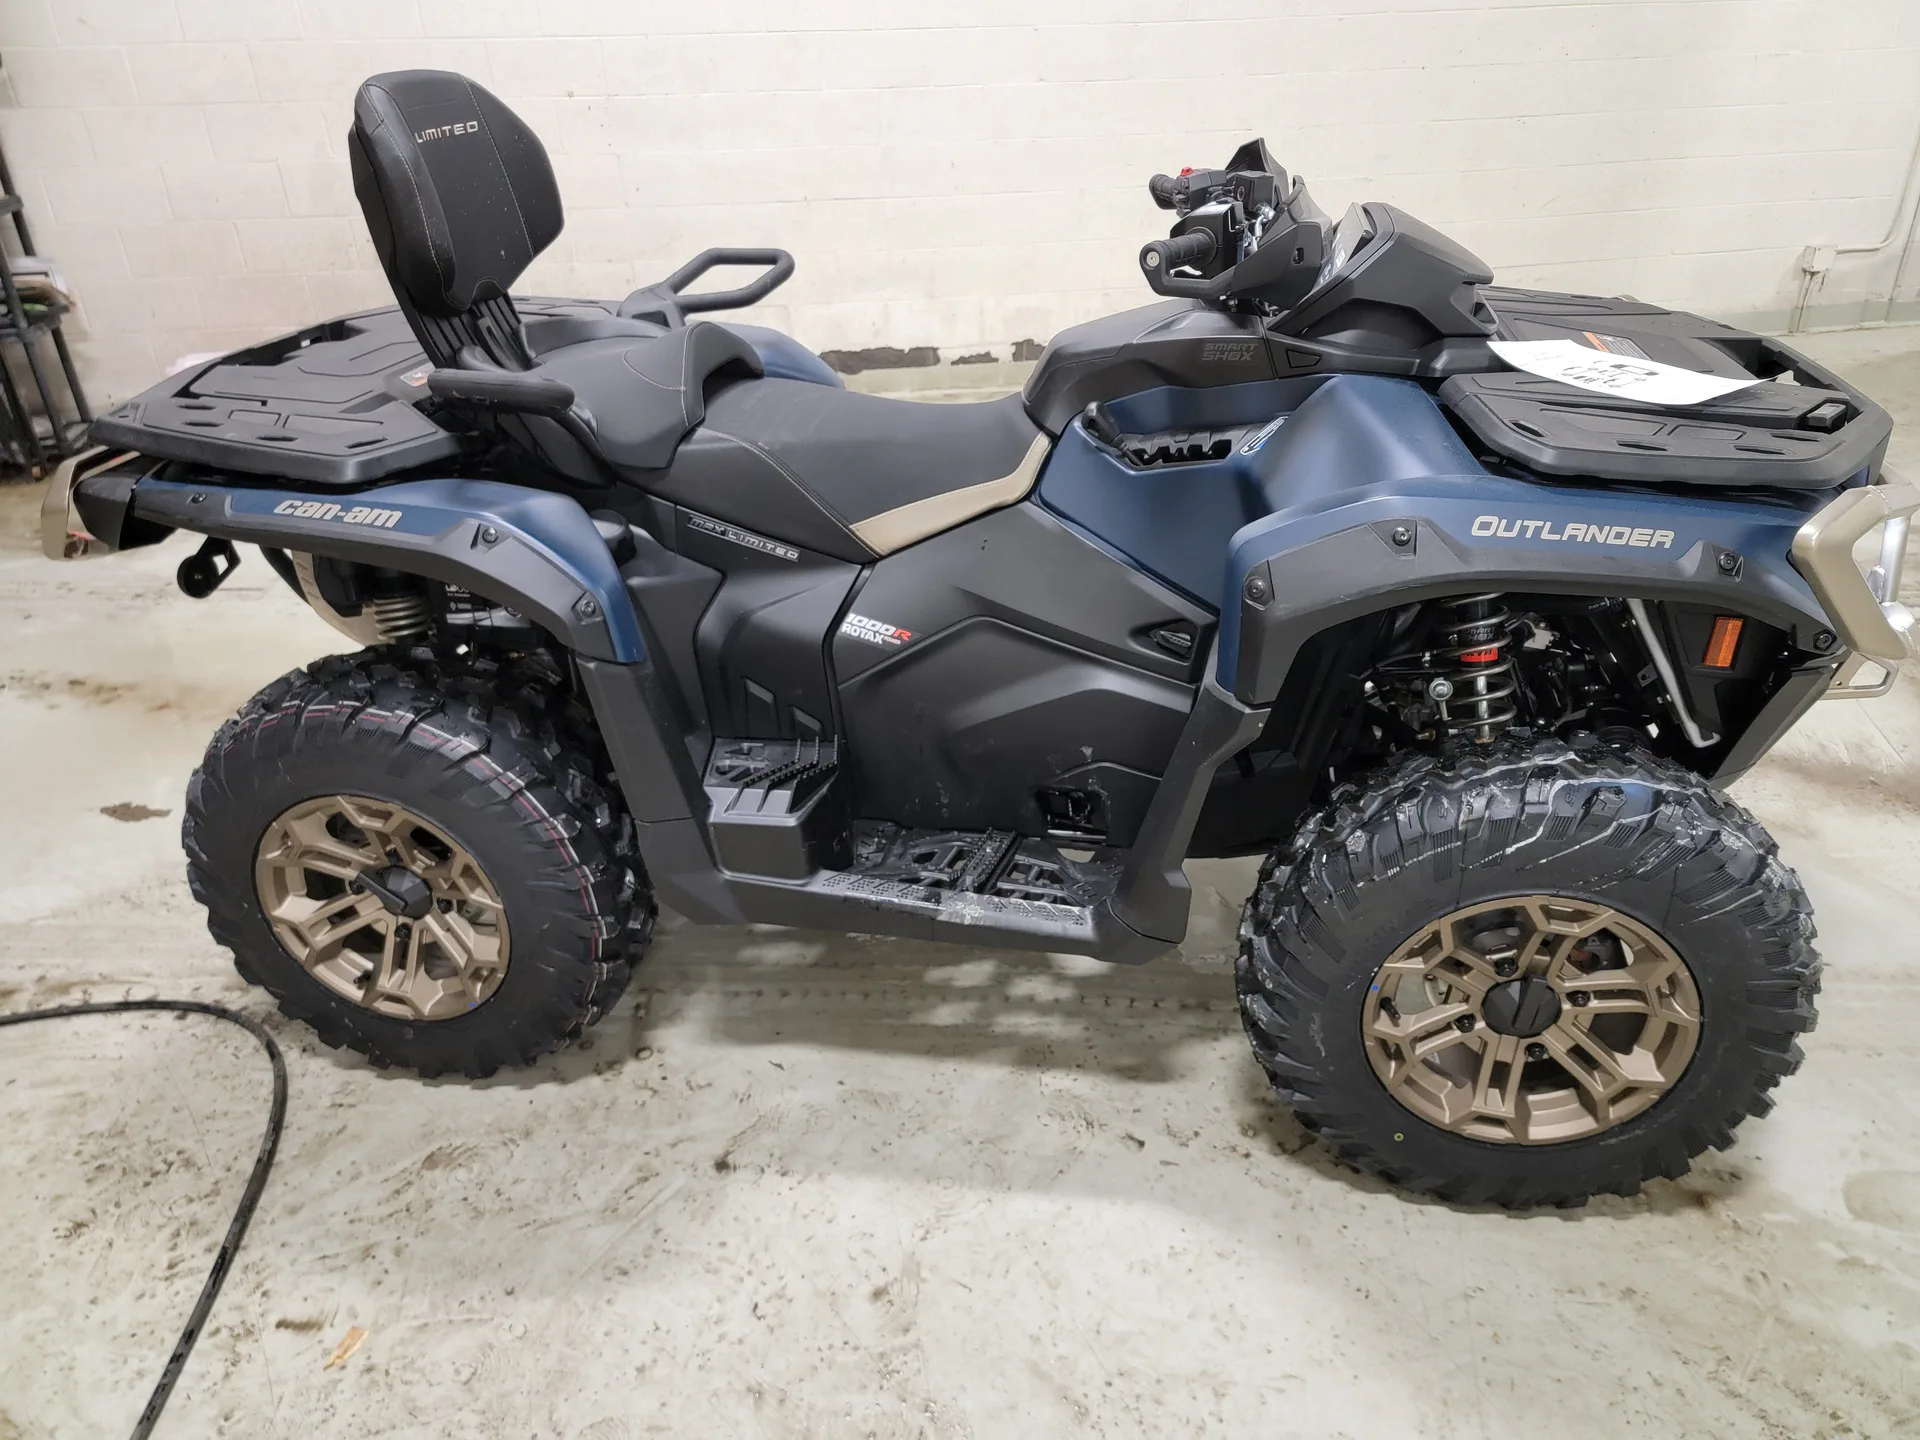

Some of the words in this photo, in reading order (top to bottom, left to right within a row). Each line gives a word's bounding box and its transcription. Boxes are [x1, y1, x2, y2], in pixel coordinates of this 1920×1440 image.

[415, 121, 479, 143] LIMITED
[1203, 342, 1259, 351] SMART
[273, 499, 402, 528] can-am
[689, 517, 725, 535] MAX
[728, 529, 799, 560] LIMITED
[1471, 515, 1675, 549] OUTLANDER
[841, 622, 884, 645] ROTAX
[844, 613, 912, 641] 1000R
